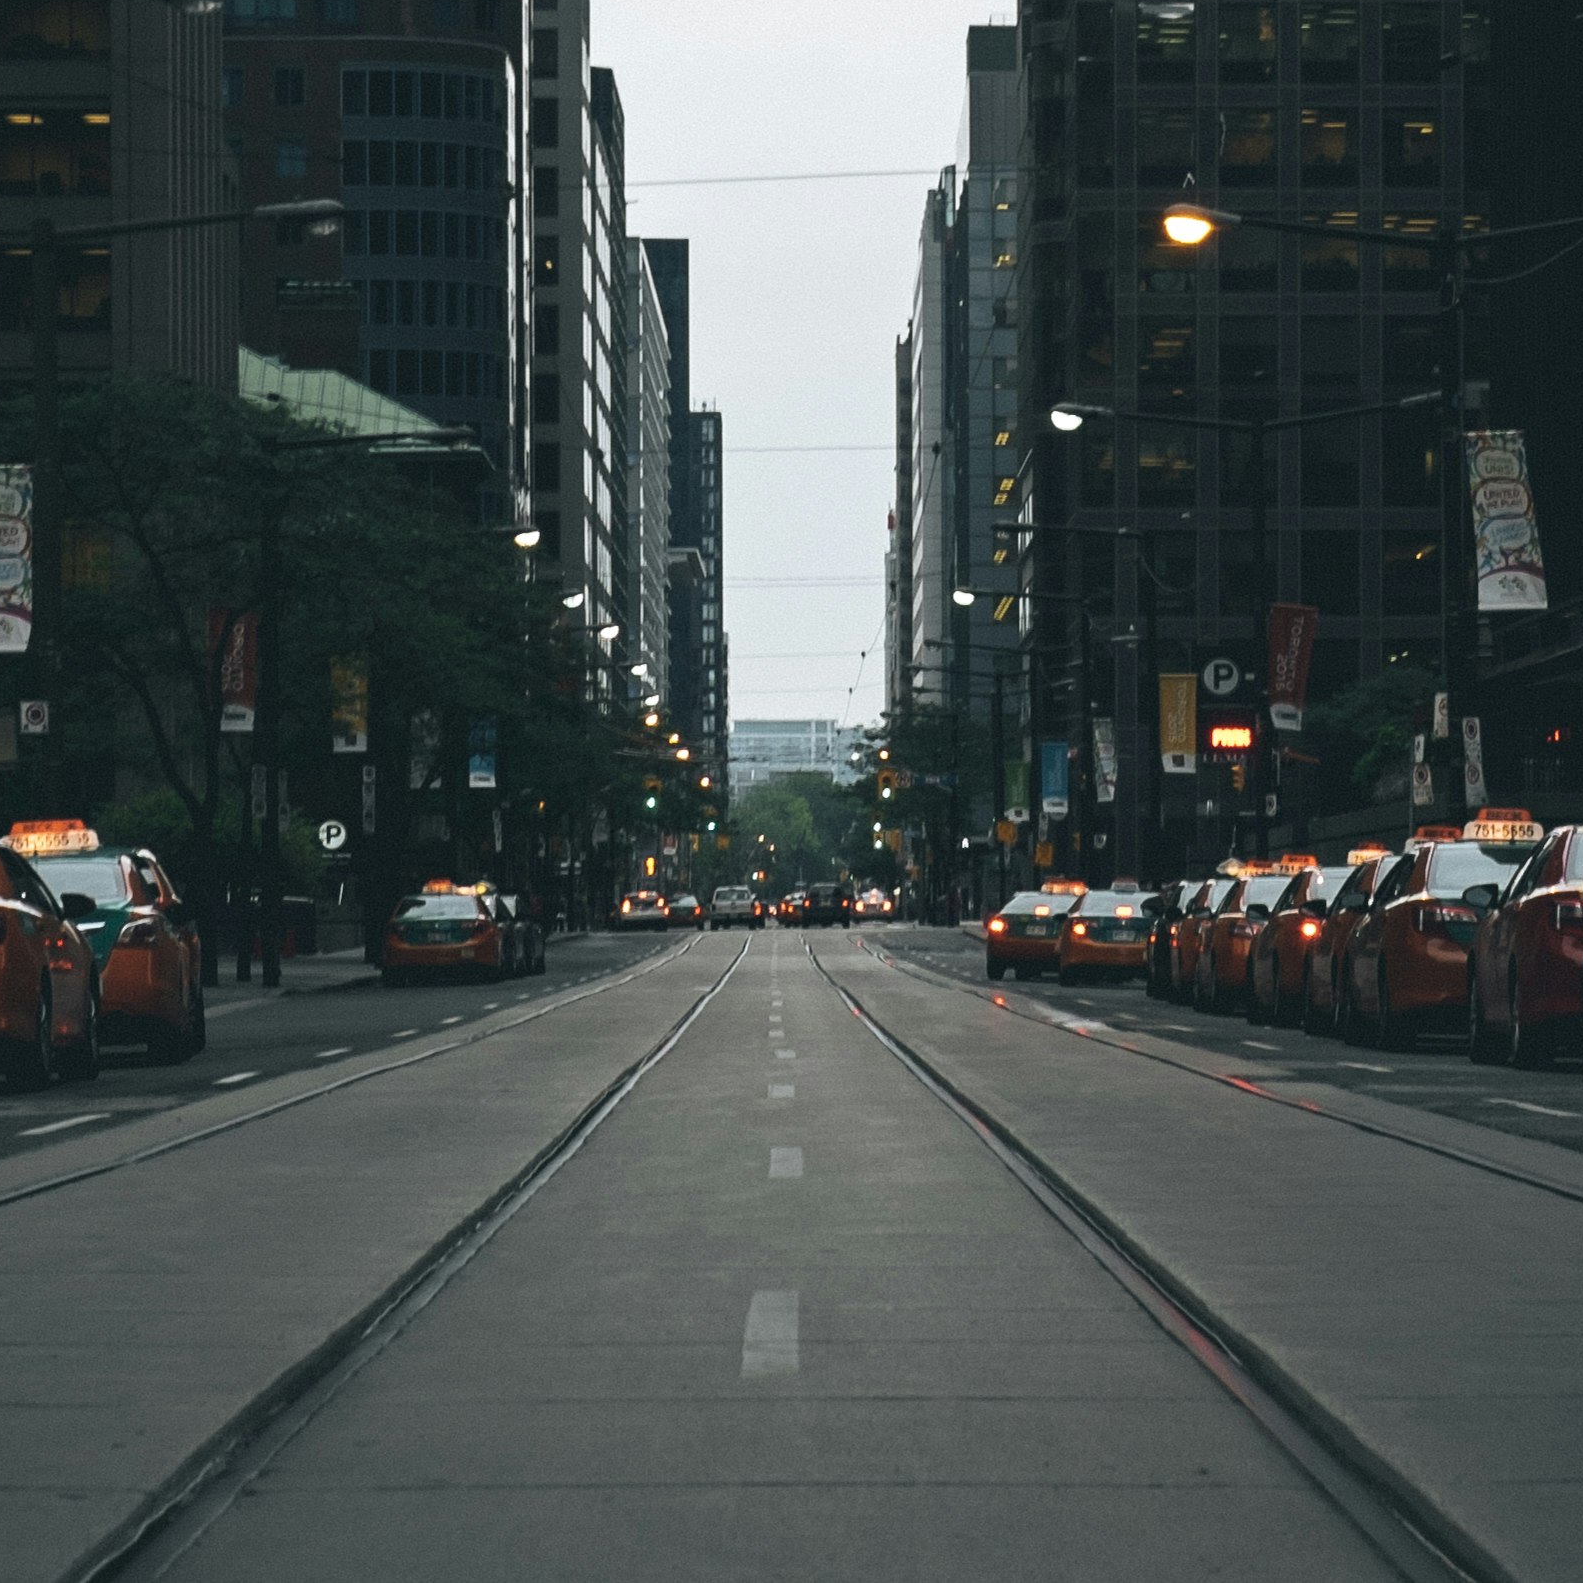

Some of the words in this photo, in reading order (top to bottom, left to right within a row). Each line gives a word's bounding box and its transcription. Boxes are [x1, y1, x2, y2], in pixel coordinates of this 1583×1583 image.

[1285, 616, 1305, 692] TORONTO
[1213, 662, 1234, 691] P
[1275, 654, 1288, 691] 2015
[1474, 824, 1535, 837] 751-5555
